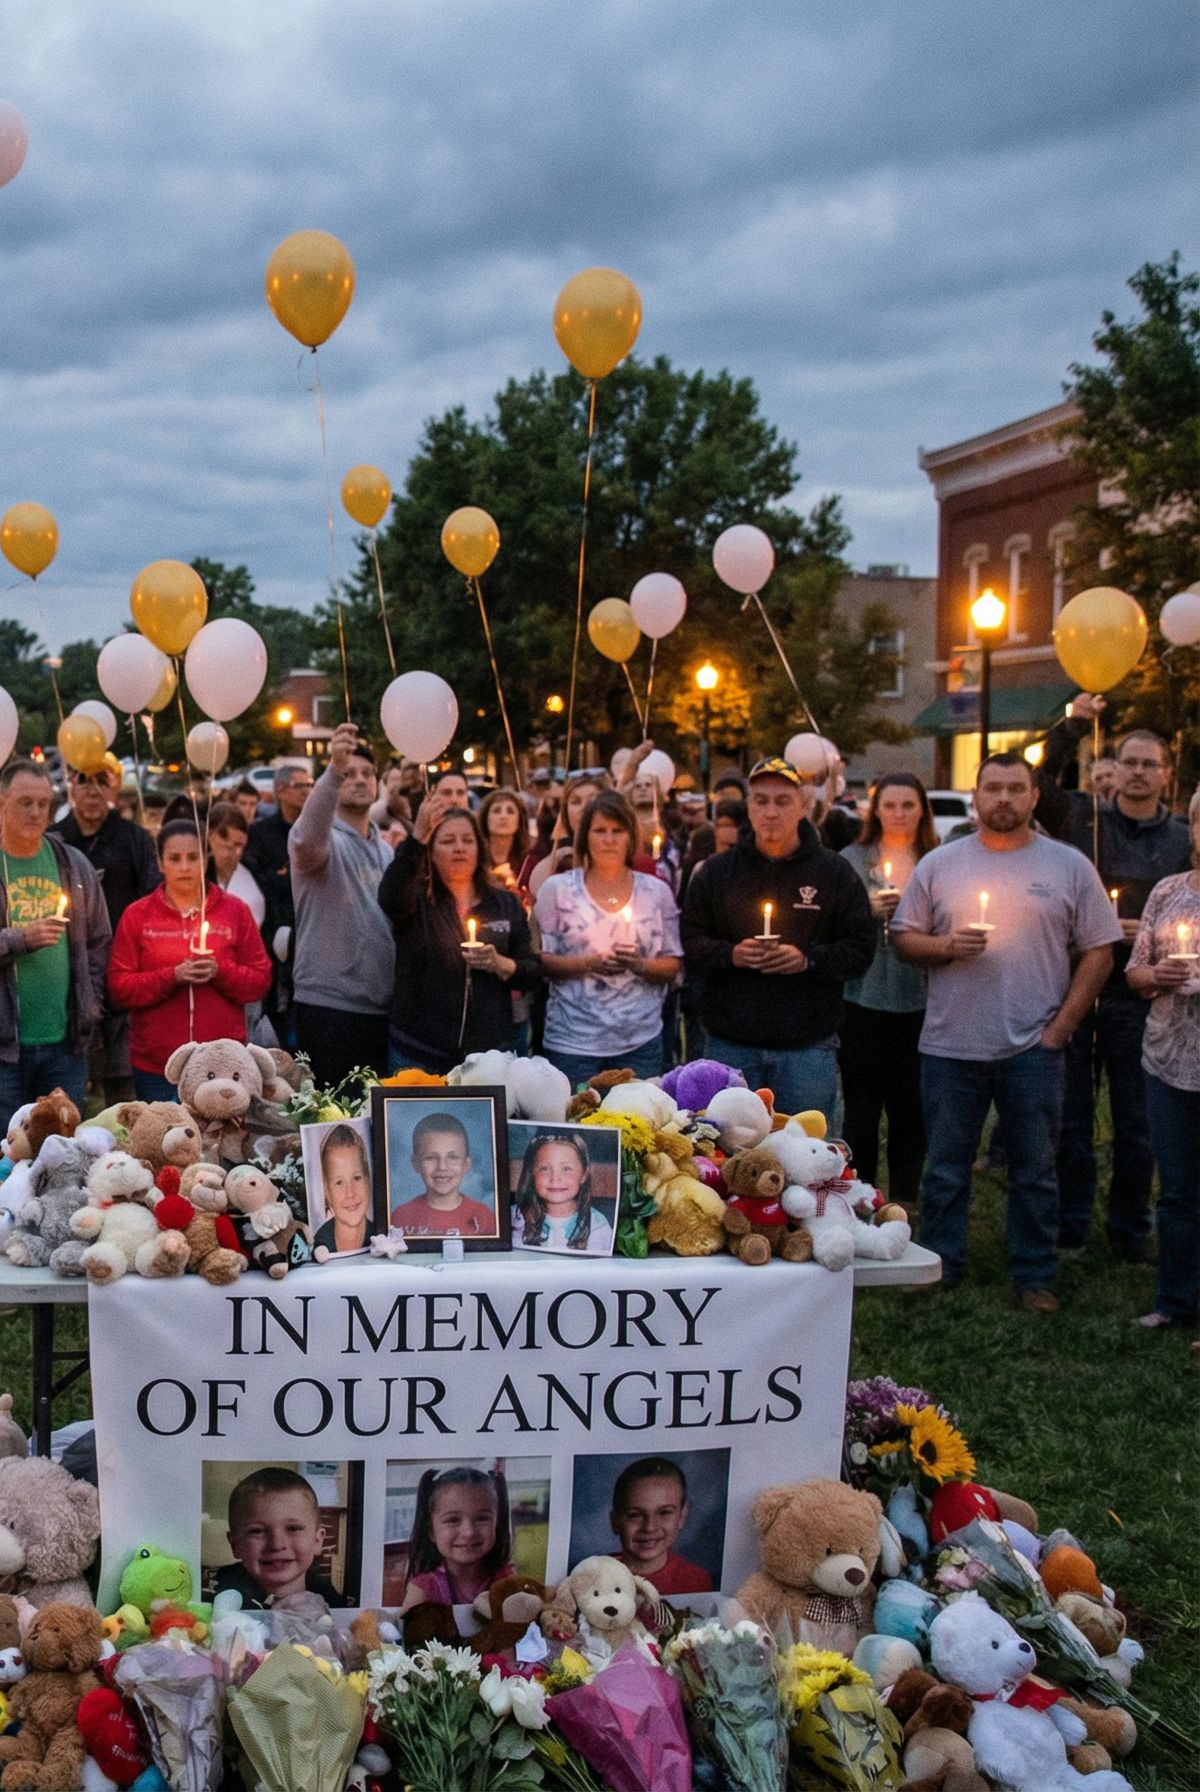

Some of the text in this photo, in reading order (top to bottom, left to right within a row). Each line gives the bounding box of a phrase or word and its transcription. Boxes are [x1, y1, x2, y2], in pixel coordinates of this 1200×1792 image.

[225, 1287, 723, 1355] IN MEMORY
[136, 1364, 803, 1438] OF OUR ANGELS
